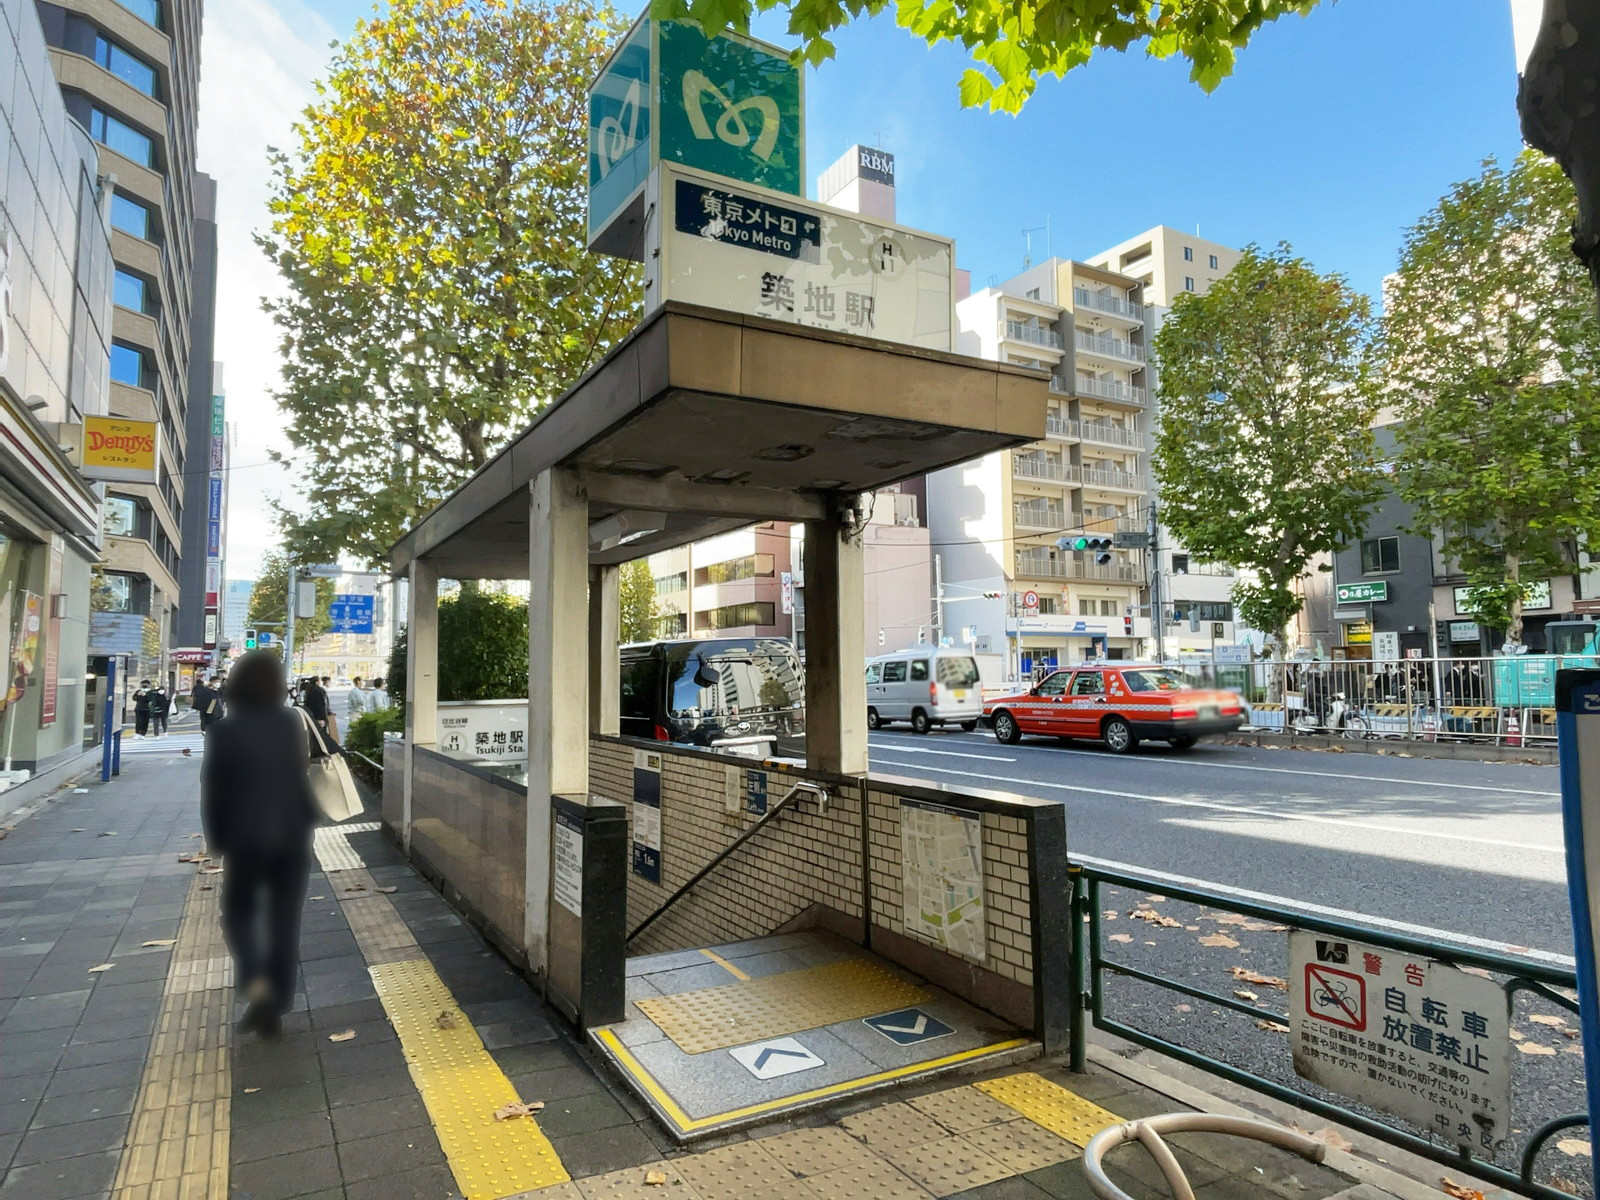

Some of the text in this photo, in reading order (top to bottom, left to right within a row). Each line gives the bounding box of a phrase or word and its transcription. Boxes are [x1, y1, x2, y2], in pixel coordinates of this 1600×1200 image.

[860, 152, 894, 174] RBM
[703, 194, 796, 236] 東京メトロ
[752, 230, 791, 251] Metro
[882, 243, 892, 256] H
[761, 271, 875, 330] 築地駅
[87, 431, 154, 455] Denny's
[102, 455, 136, 463] レストラン
[475, 731, 523, 745] 築地駅
[475, 745, 525, 755] Tsukiji Sta.
[1363, 952, 1425, 987] 警告
[1385, 987, 1489, 1040] 自転車
[1383, 1015, 1490, 1074] 放置禁止
[1435, 1113, 1494, 1150] 中央区
